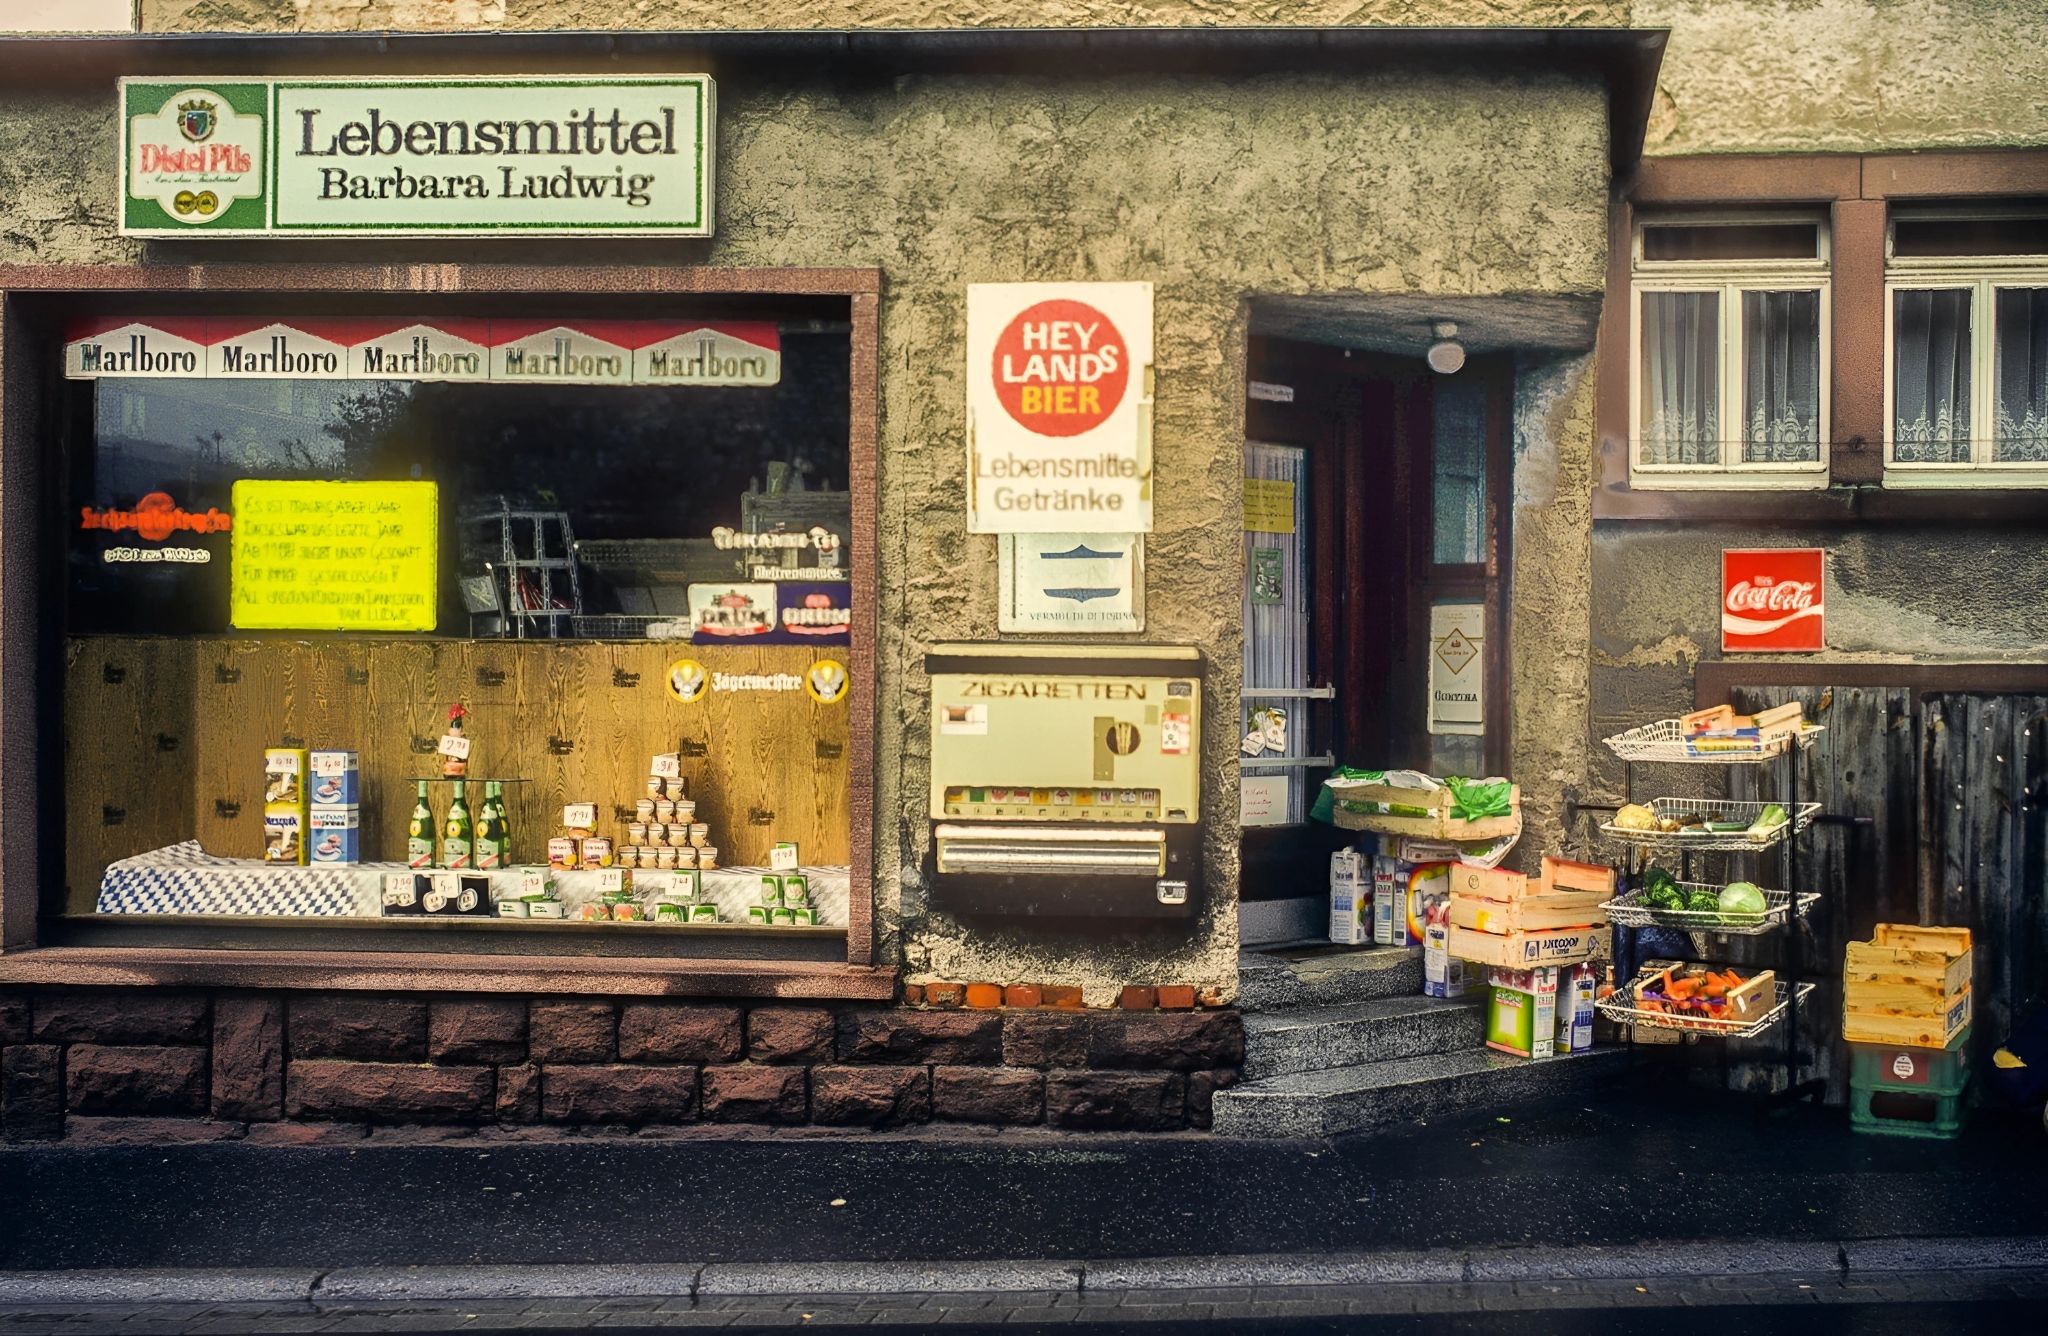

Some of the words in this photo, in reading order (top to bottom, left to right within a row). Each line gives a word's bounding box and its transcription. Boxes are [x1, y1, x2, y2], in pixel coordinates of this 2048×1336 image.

[296, 106, 680, 158] Lebensmittel
[210, 143, 252, 173] Pils
[317, 166, 489, 200] Barbara
[497, 165, 656, 207] Ludwig
[80, 334, 197, 374] Marlboro
[221, 335, 338, 374] Marlboro
[362, 336, 480, 375] Marlboro
[1022, 321, 1100, 352] HEY
[504, 337, 622, 377] Marlboro
[649, 337, 767, 378] Marlboro
[1021, 385, 1103, 416] BIER
[975, 452, 1139, 480] Lebensmitte
[994, 485, 1124, 512] Getränke
[959, 680, 1148, 701] ZIGARETTEN
